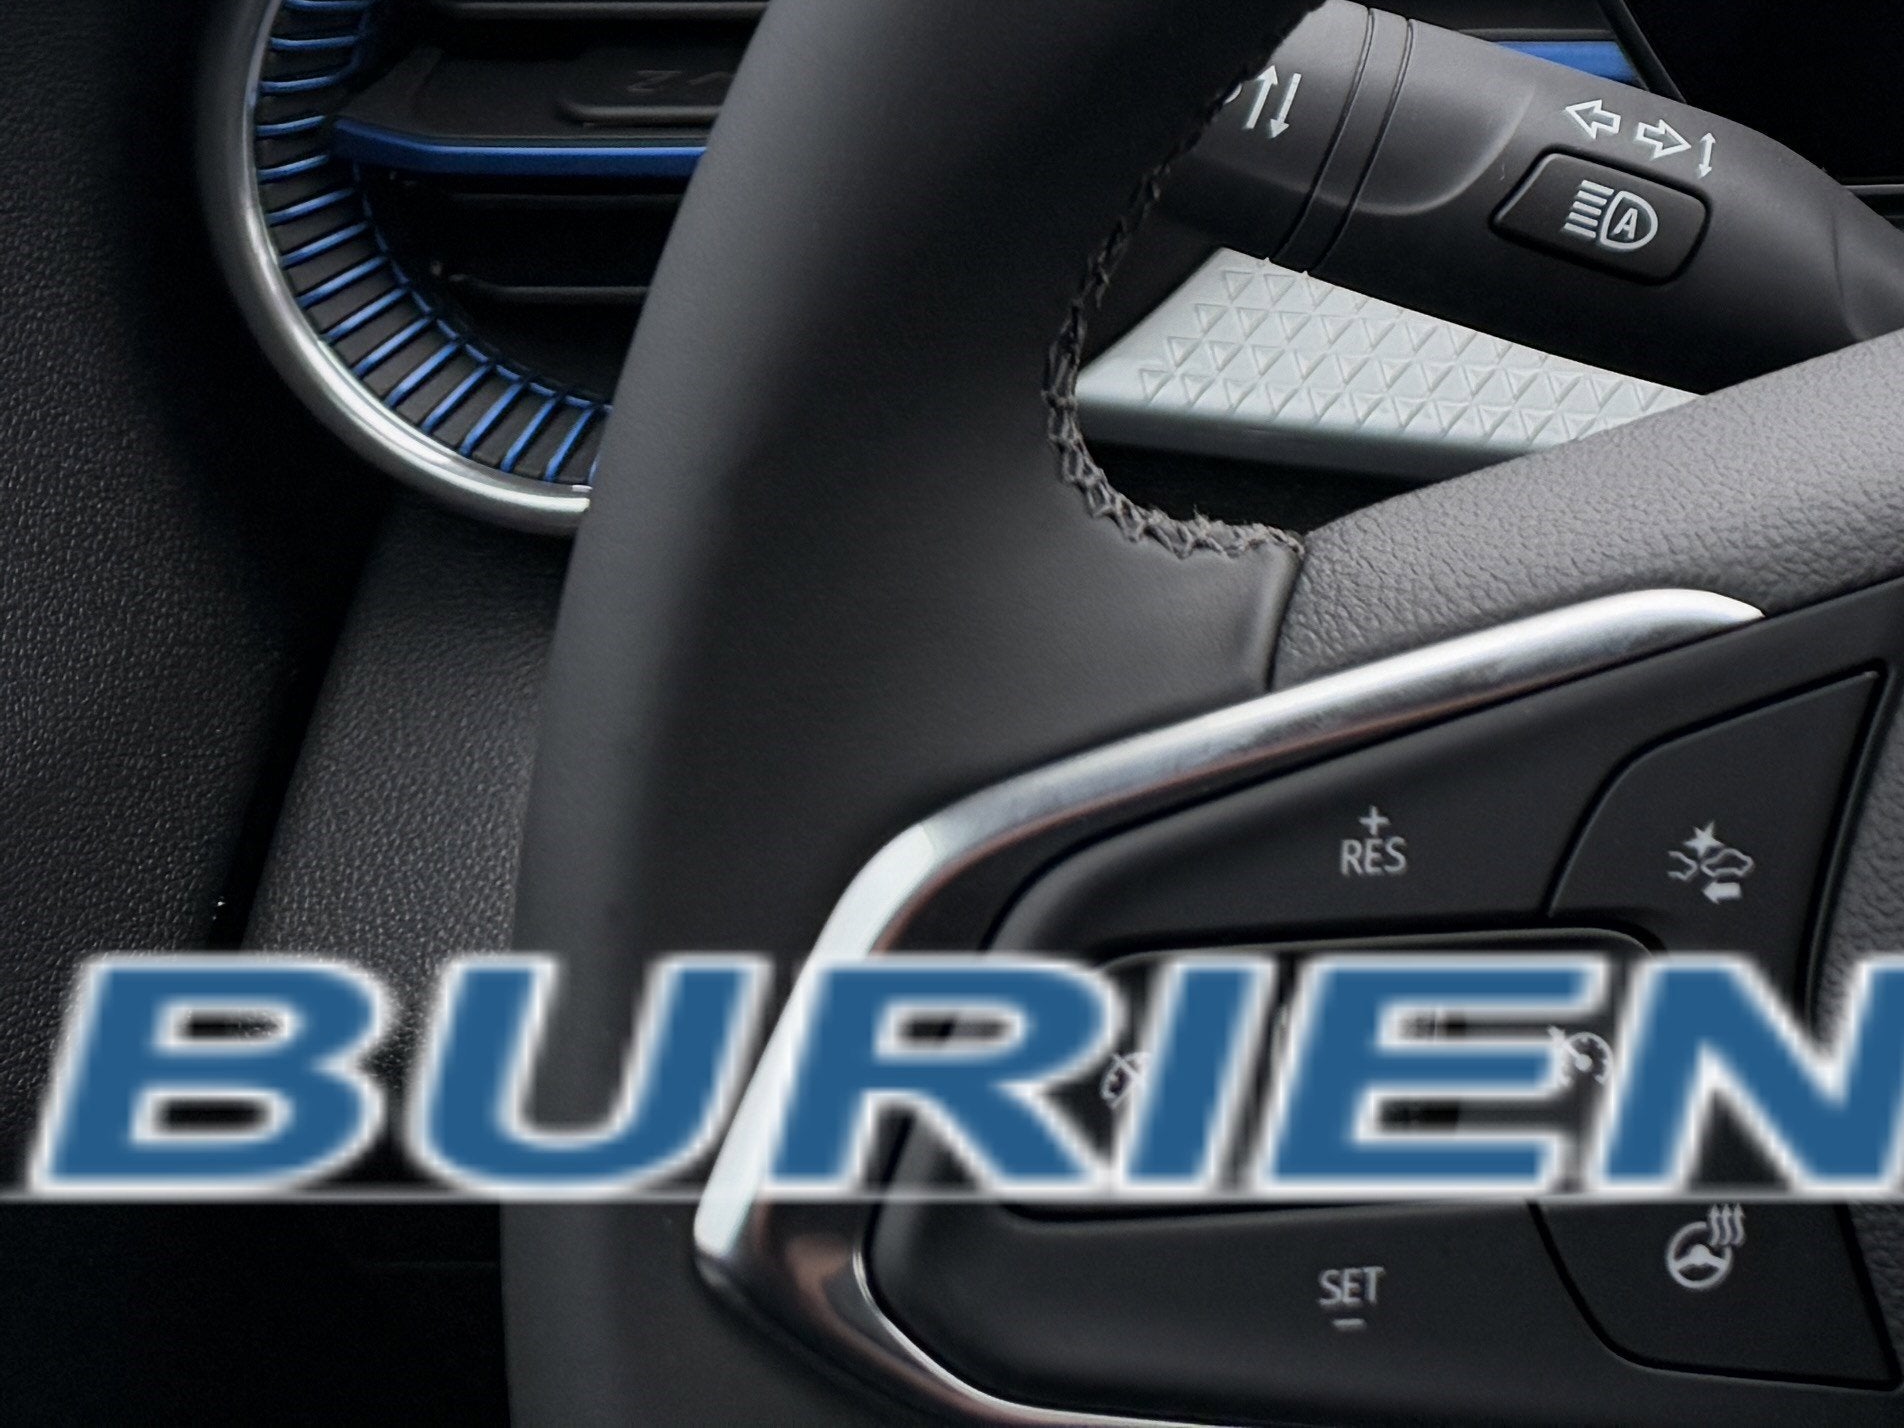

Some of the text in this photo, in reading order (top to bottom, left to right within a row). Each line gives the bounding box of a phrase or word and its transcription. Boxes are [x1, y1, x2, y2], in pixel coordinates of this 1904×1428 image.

[1611, 207, 1639, 240] A
[1341, 836, 1408, 877] RES
[1318, 1266, 1386, 1307] SET
